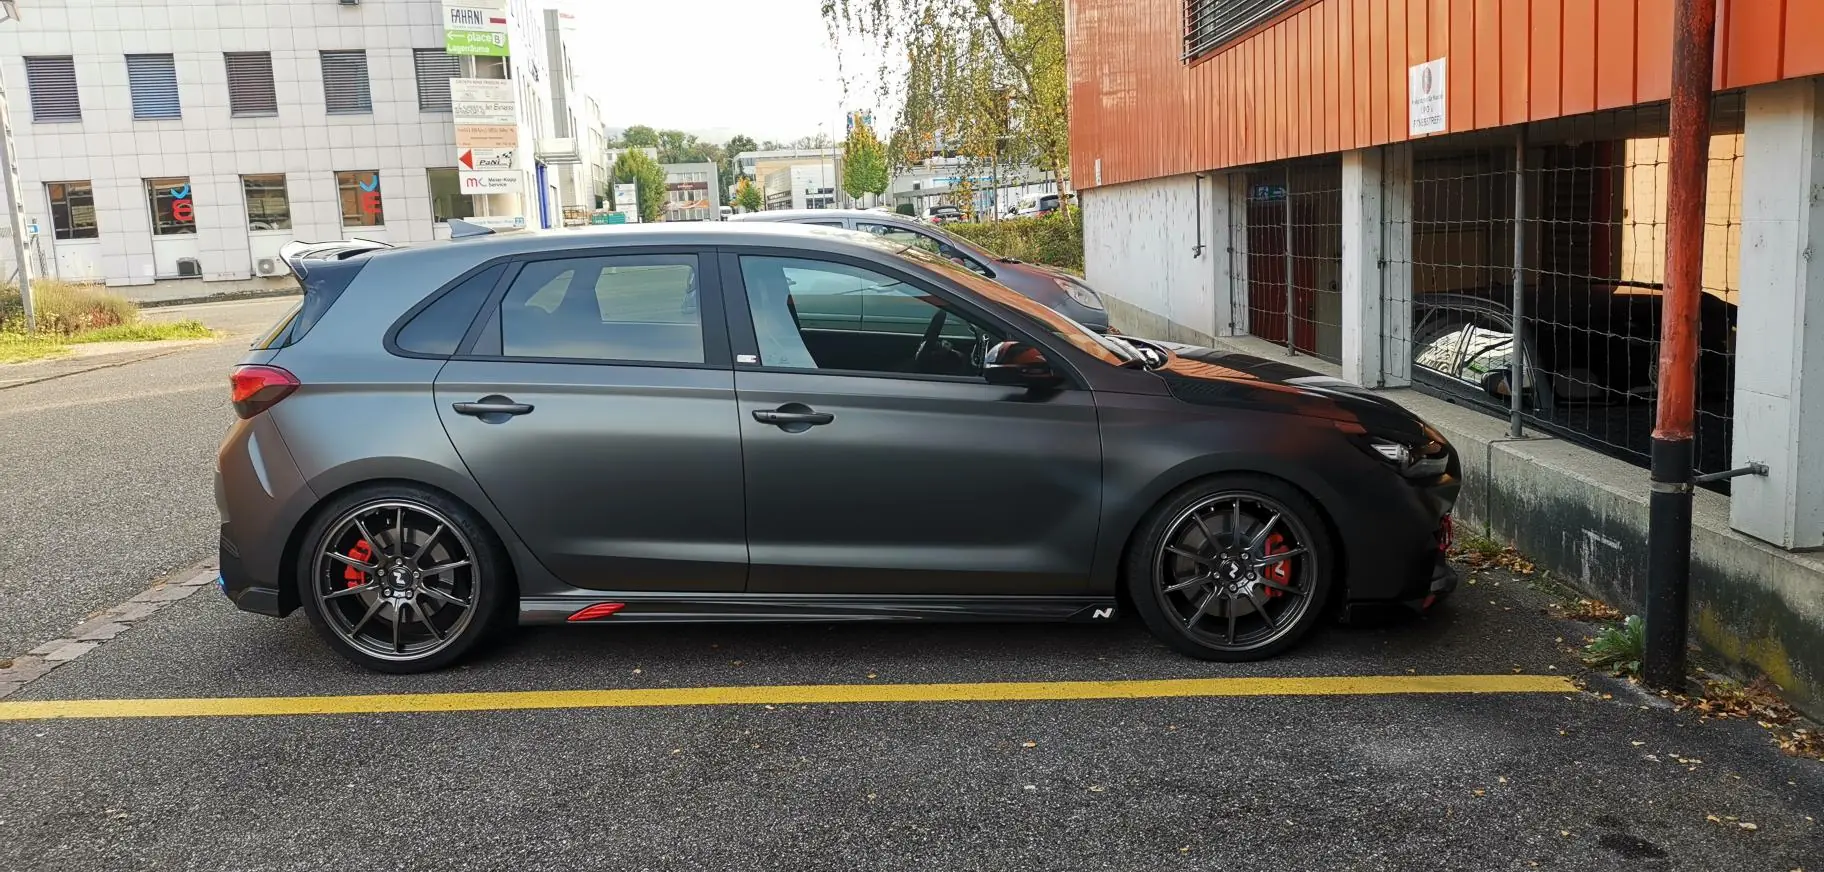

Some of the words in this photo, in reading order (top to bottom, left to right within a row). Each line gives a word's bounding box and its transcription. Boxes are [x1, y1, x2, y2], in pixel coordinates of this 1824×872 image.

[451, 9, 484, 25] FAHRNI
[467, 32, 492, 44] place
[1092, 607, 1113, 619] N
